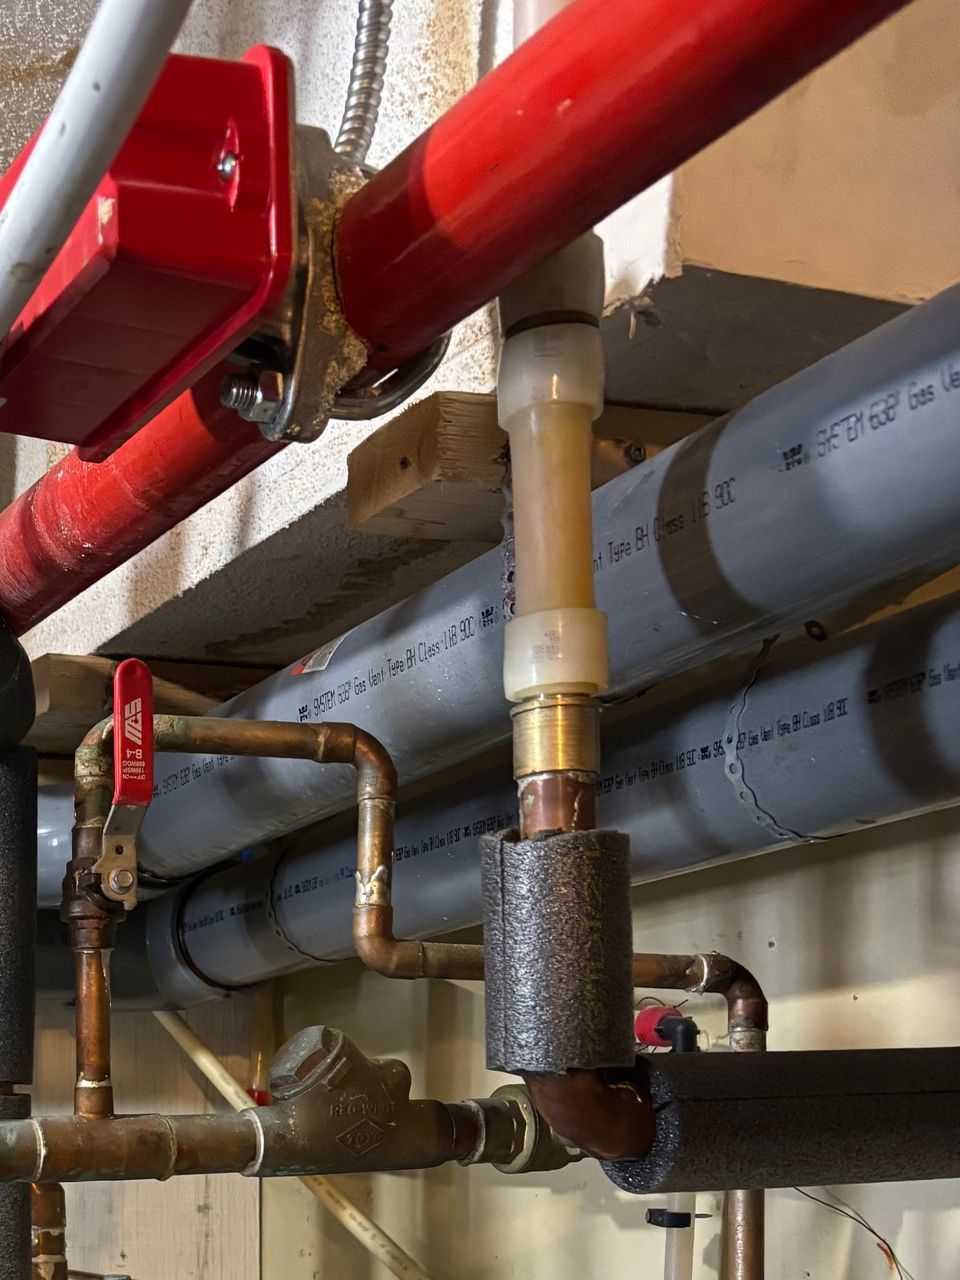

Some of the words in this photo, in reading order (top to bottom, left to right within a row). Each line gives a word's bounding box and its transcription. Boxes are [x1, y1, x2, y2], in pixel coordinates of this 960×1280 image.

[907, 381, 935, 410] Gas
[608, 541, 631, 564] Type
[635, 524, 649, 551] BH
[654, 515, 684, 541] Class
[354, 676, 366, 695] Gas
[369, 666, 384, 687] Vent
[387, 658, 404, 678] Type
[406, 649, 416, 669] BH
[418, 642, 440, 663] Class
[459, 616, 474, 641] 90C
[126, 748, 143, 759] B-4
